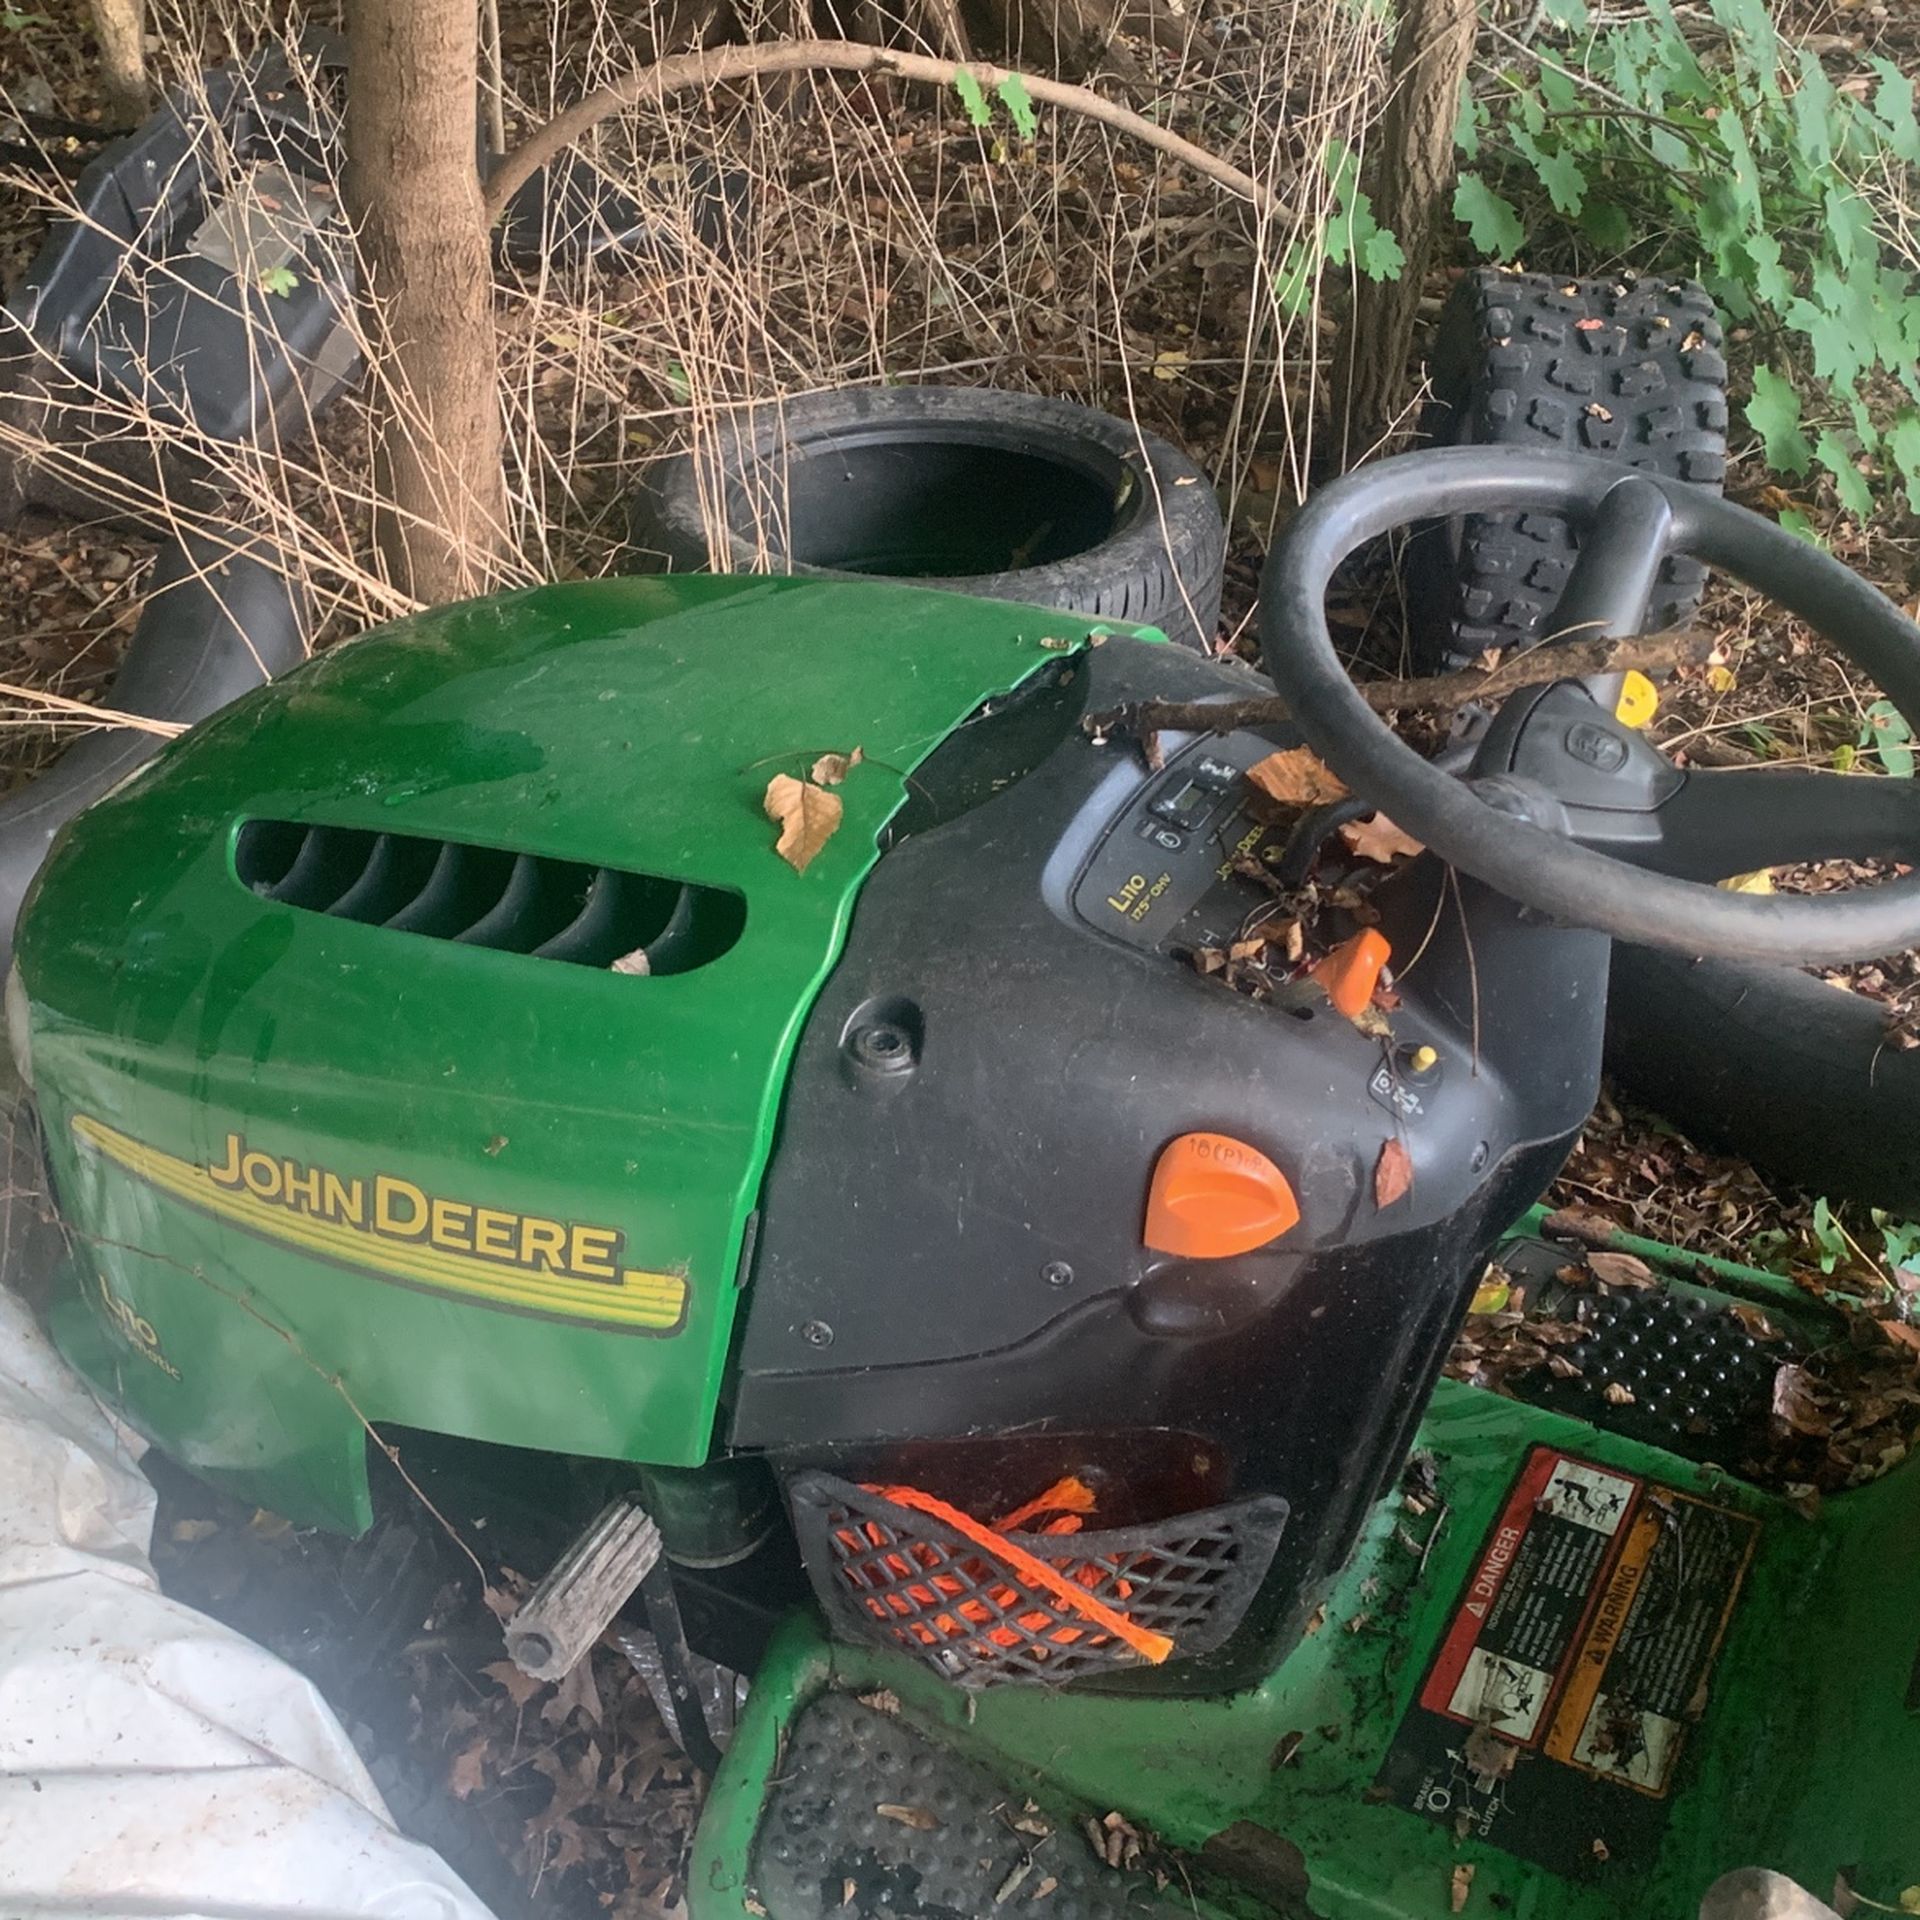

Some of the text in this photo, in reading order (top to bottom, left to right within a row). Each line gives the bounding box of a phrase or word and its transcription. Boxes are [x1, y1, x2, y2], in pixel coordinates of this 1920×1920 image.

[1215, 849, 1241, 882] JO
[1236, 824, 1267, 854] DEE
[1107, 874, 1146, 913] L110
[1150, 872, 1171, 898] OHV
[208, 1132, 620, 1280] JOHN DEERE
[1474, 1526, 1521, 1598] DANGER
[1593, 1562, 1639, 1646] WARNING
[1413, 1776, 1435, 1811] BRAKE
[1477, 1796, 1500, 1837] CLUTCH
